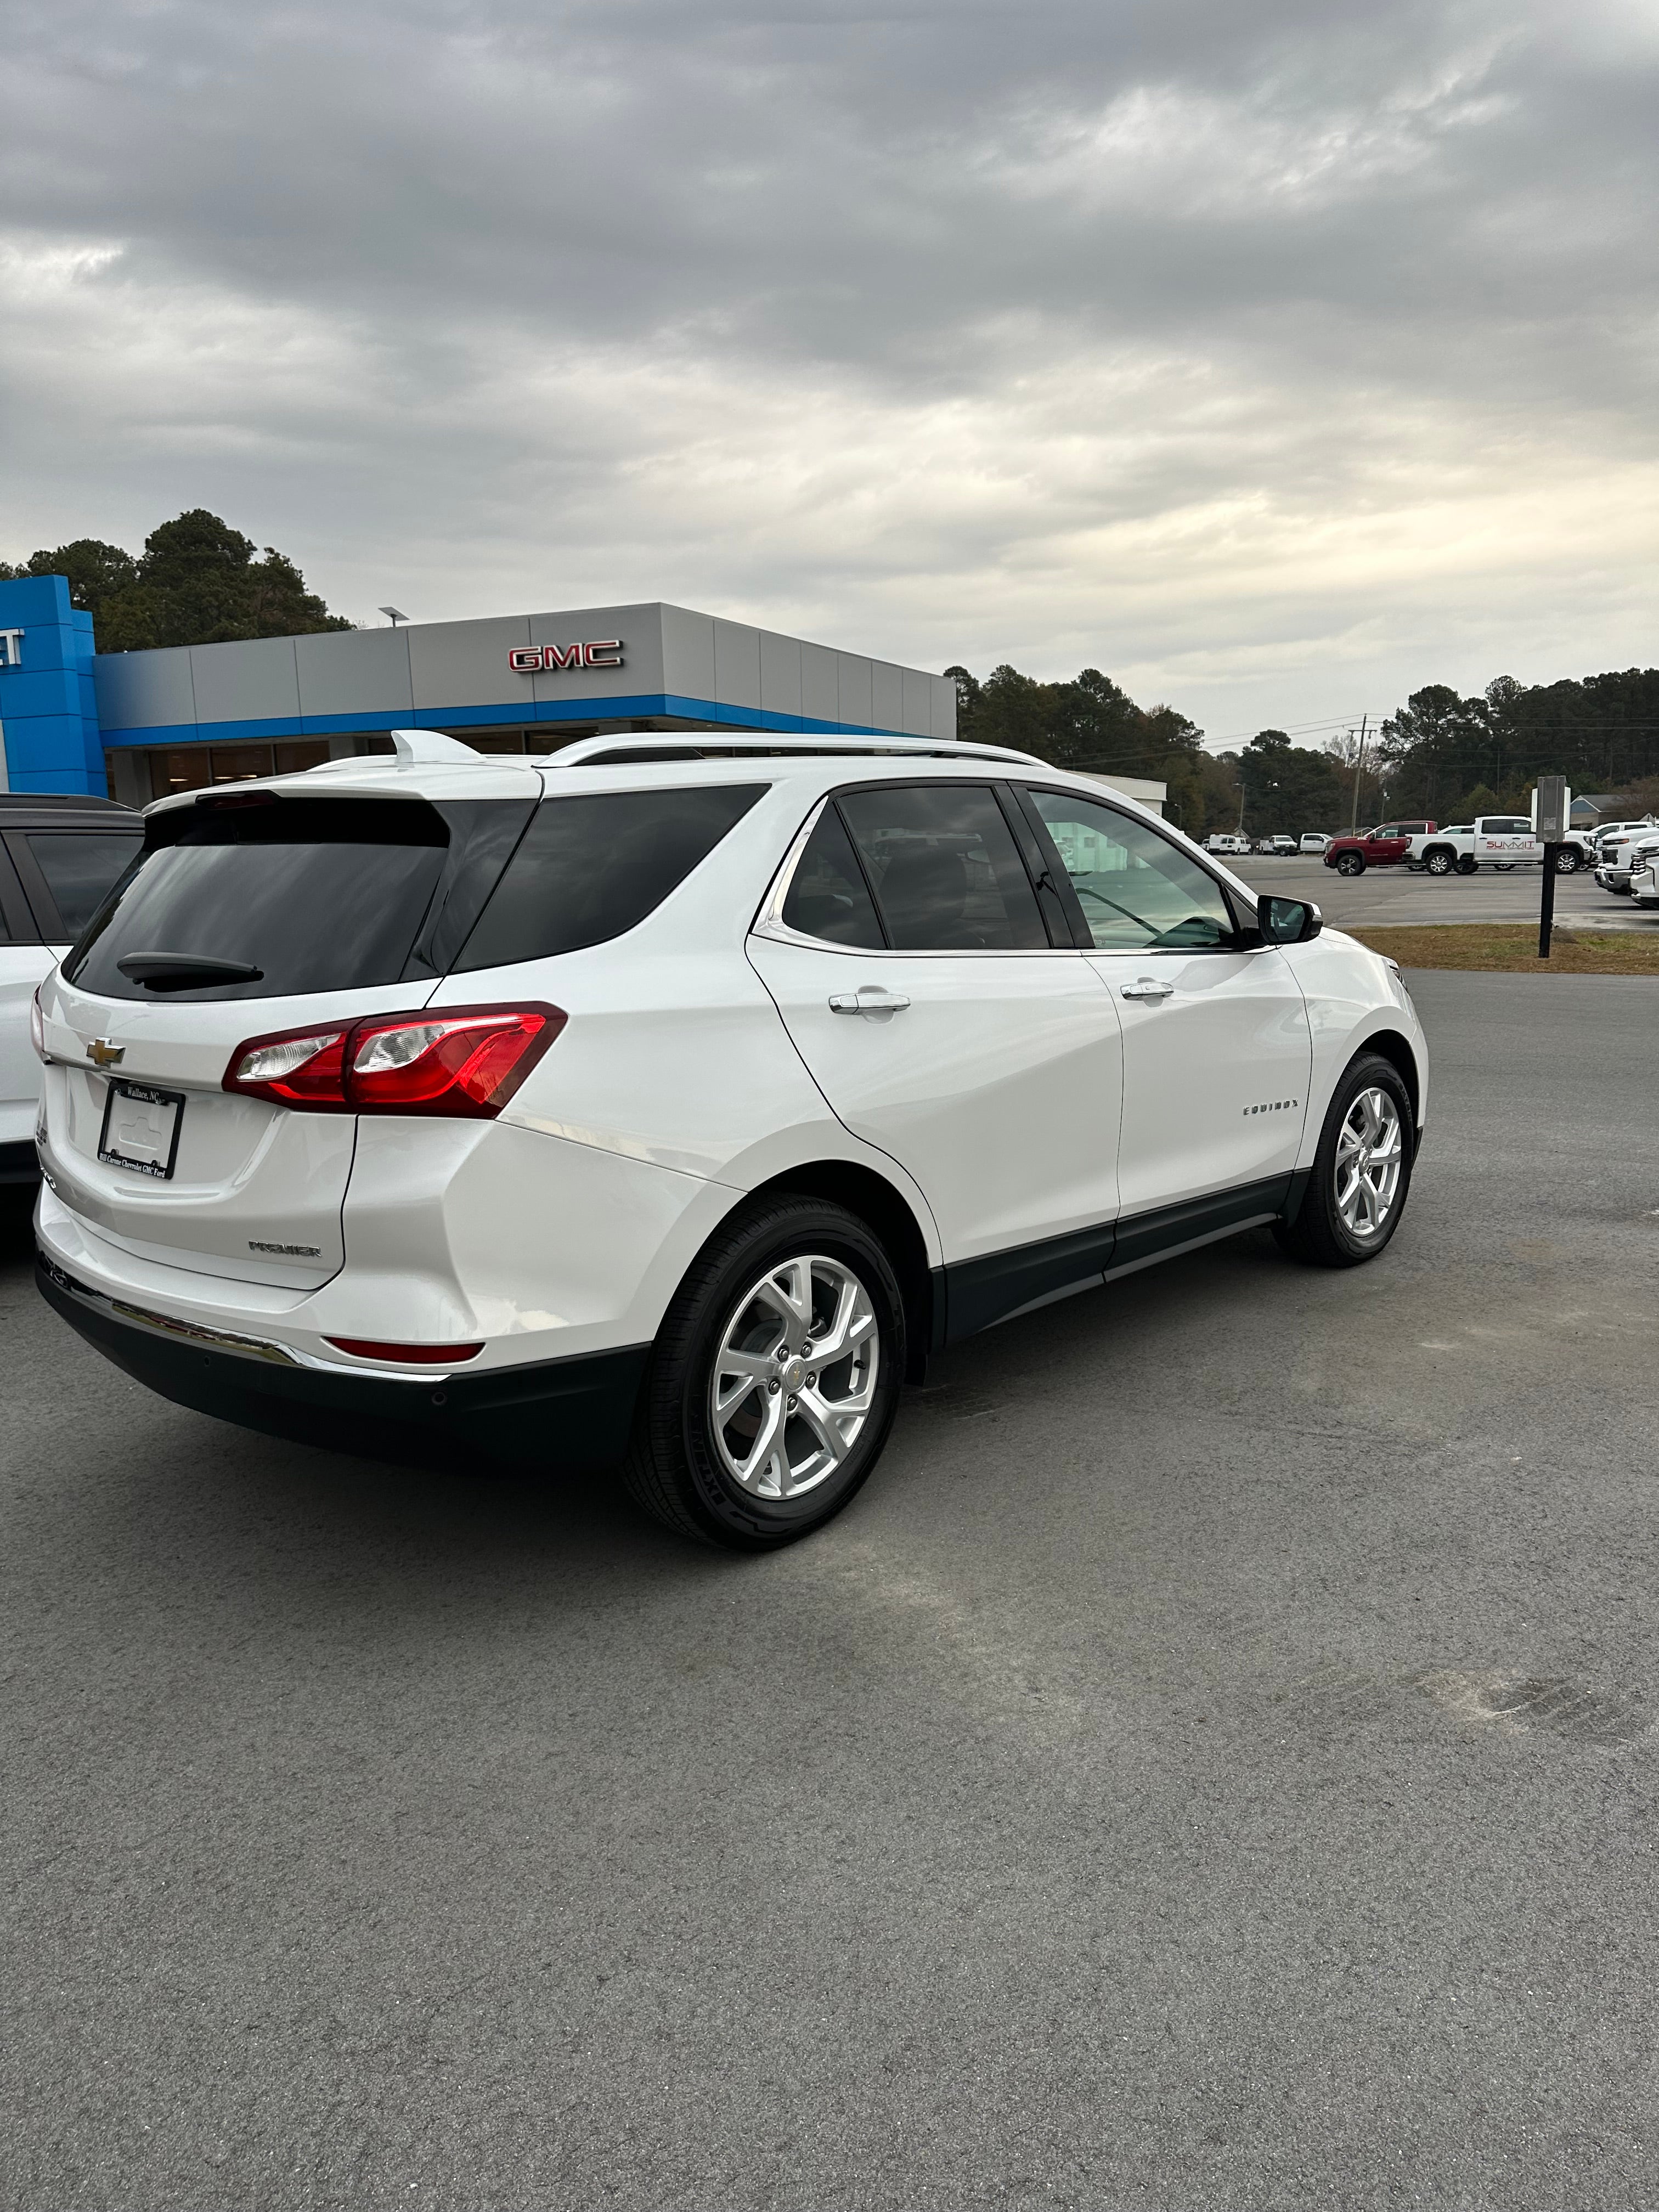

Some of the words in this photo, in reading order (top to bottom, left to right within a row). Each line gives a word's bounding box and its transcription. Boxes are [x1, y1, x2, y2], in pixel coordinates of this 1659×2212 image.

[0, 629, 25, 665] T
[509, 640, 622, 672] GMC
[128, 1086, 148, 1101] Wallace,
[149, 1091, 159, 1101] NC
[1243, 1099, 1299, 1115] EQUINOX
[122, 1159, 142, 1171] Chevrolet
[142, 1165, 154, 1175] GMC
[154, 1168, 165, 1178] Ford
[249, 1240, 322, 1257] PREMIER
